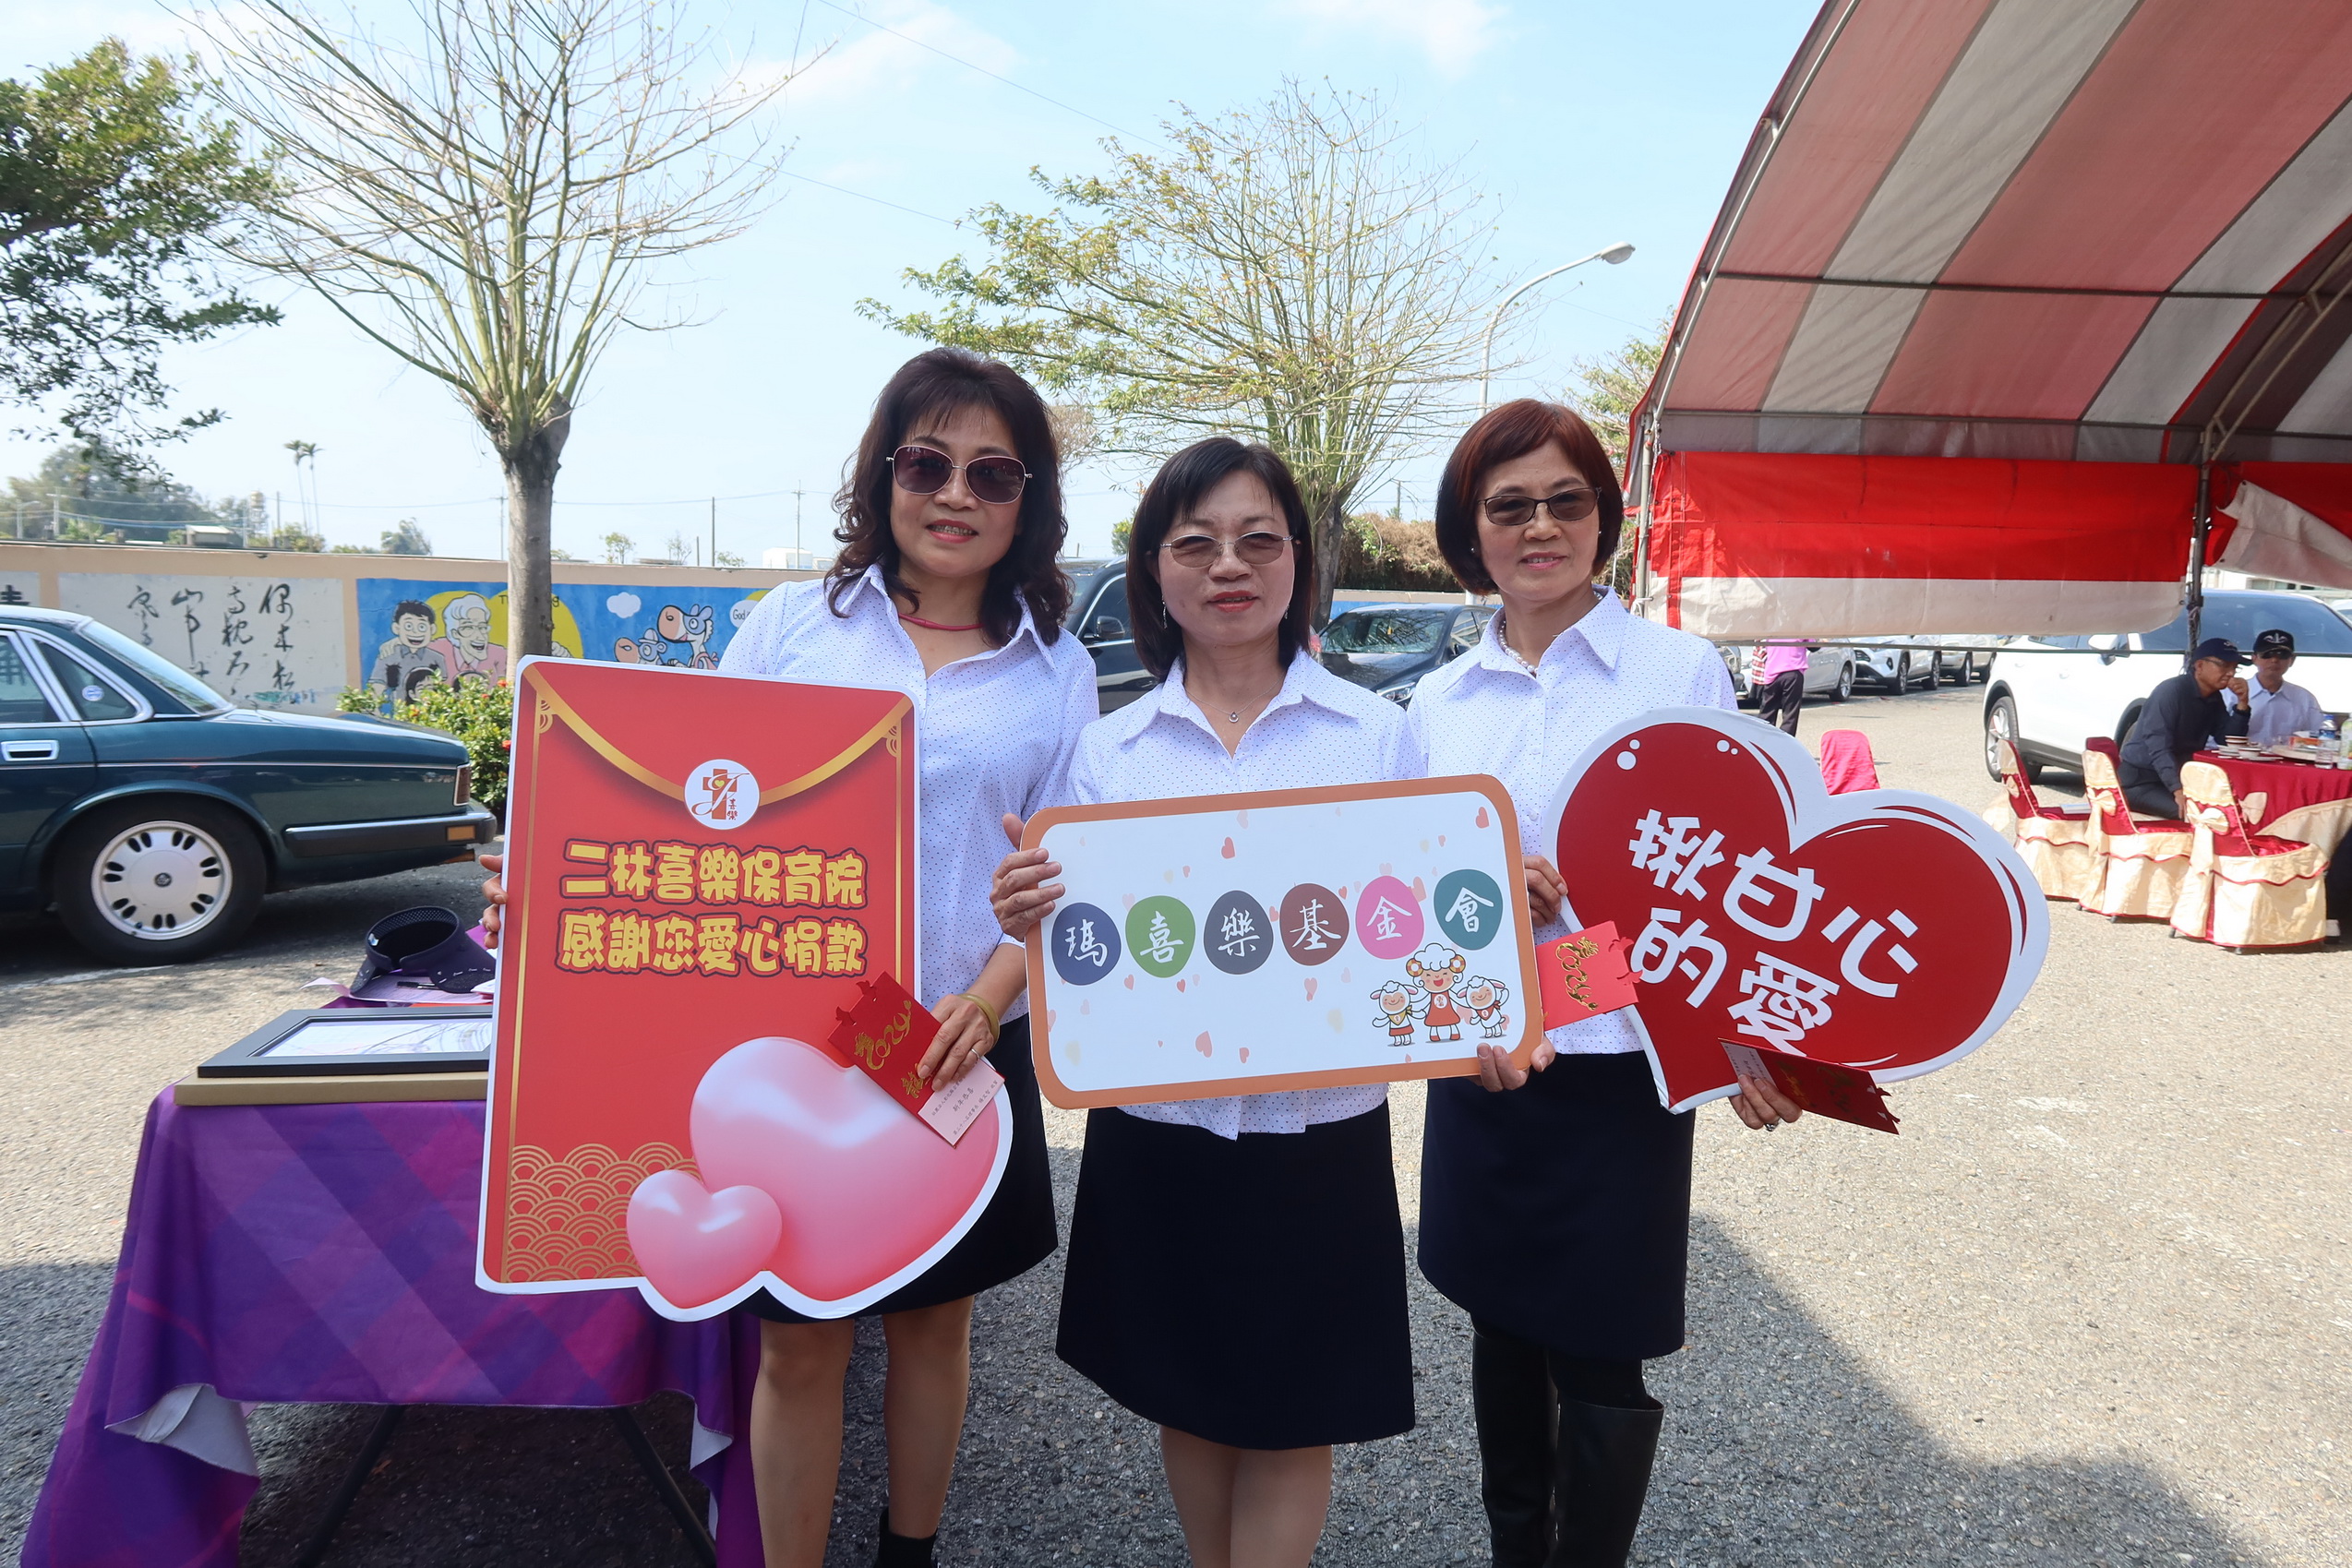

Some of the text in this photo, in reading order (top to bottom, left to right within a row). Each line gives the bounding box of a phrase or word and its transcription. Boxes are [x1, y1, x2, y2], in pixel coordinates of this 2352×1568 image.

[732, 608, 746, 620] God
[561, 841, 868, 909] 二林喜樂保育院
[1628, 808, 1918, 999] 揪甘心
[558, 910, 867, 977] 感謝您愛心捐款
[1064, 886, 1494, 967] 瑪喜樂基金會
[1631, 906, 1840, 1057] 的愛
